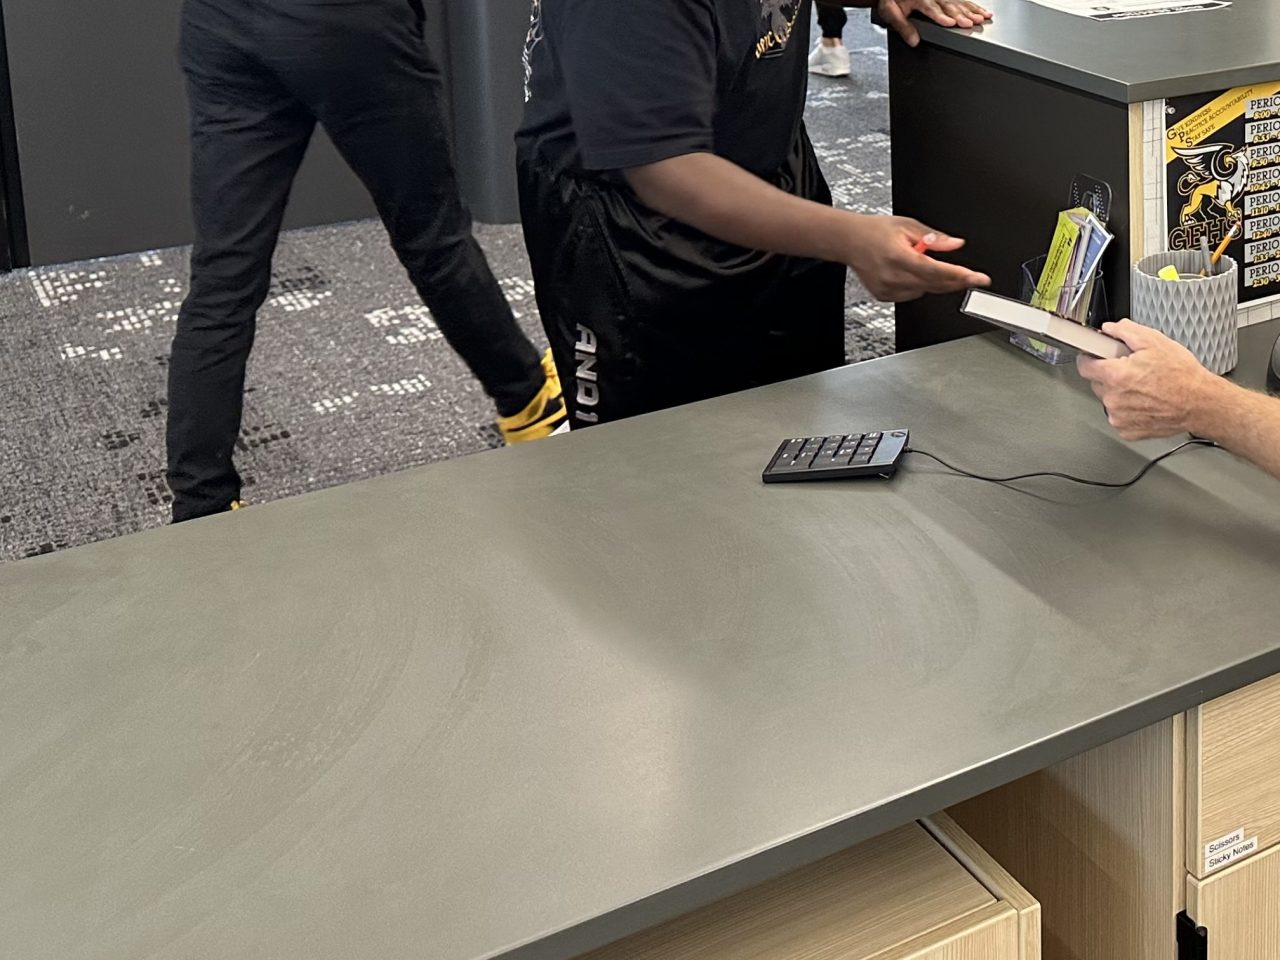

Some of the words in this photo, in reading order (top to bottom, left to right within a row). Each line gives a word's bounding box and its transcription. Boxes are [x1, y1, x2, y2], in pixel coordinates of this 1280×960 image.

[1179, 119, 1207, 143] PRACTICE
[1208, 89, 1254, 120] ACCOUNTABILITY
[1252, 108, 1271, 120] 8:00
[1166, 126, 1185, 140] GIVE
[1184, 107, 1212, 128] KINDNESS
[1185, 131, 1201, 148] STAY
[1201, 124, 1216, 135] SAFE
[1251, 157, 1269, 168] 9:50
[1249, 181, 1270, 192] 10:45
[1251, 205, 1269, 217] 11:10
[1168, 217, 1243, 251] GEHS
[1252, 227, 1272, 240] 12:40
[1253, 251, 1270, 264] 1:35
[1252, 275, 1270, 288] 2:30
[1209, 833, 1241, 853] Scissors
[1209, 853, 1231, 868] Sticky
[1232, 840, 1255, 857] Notes
